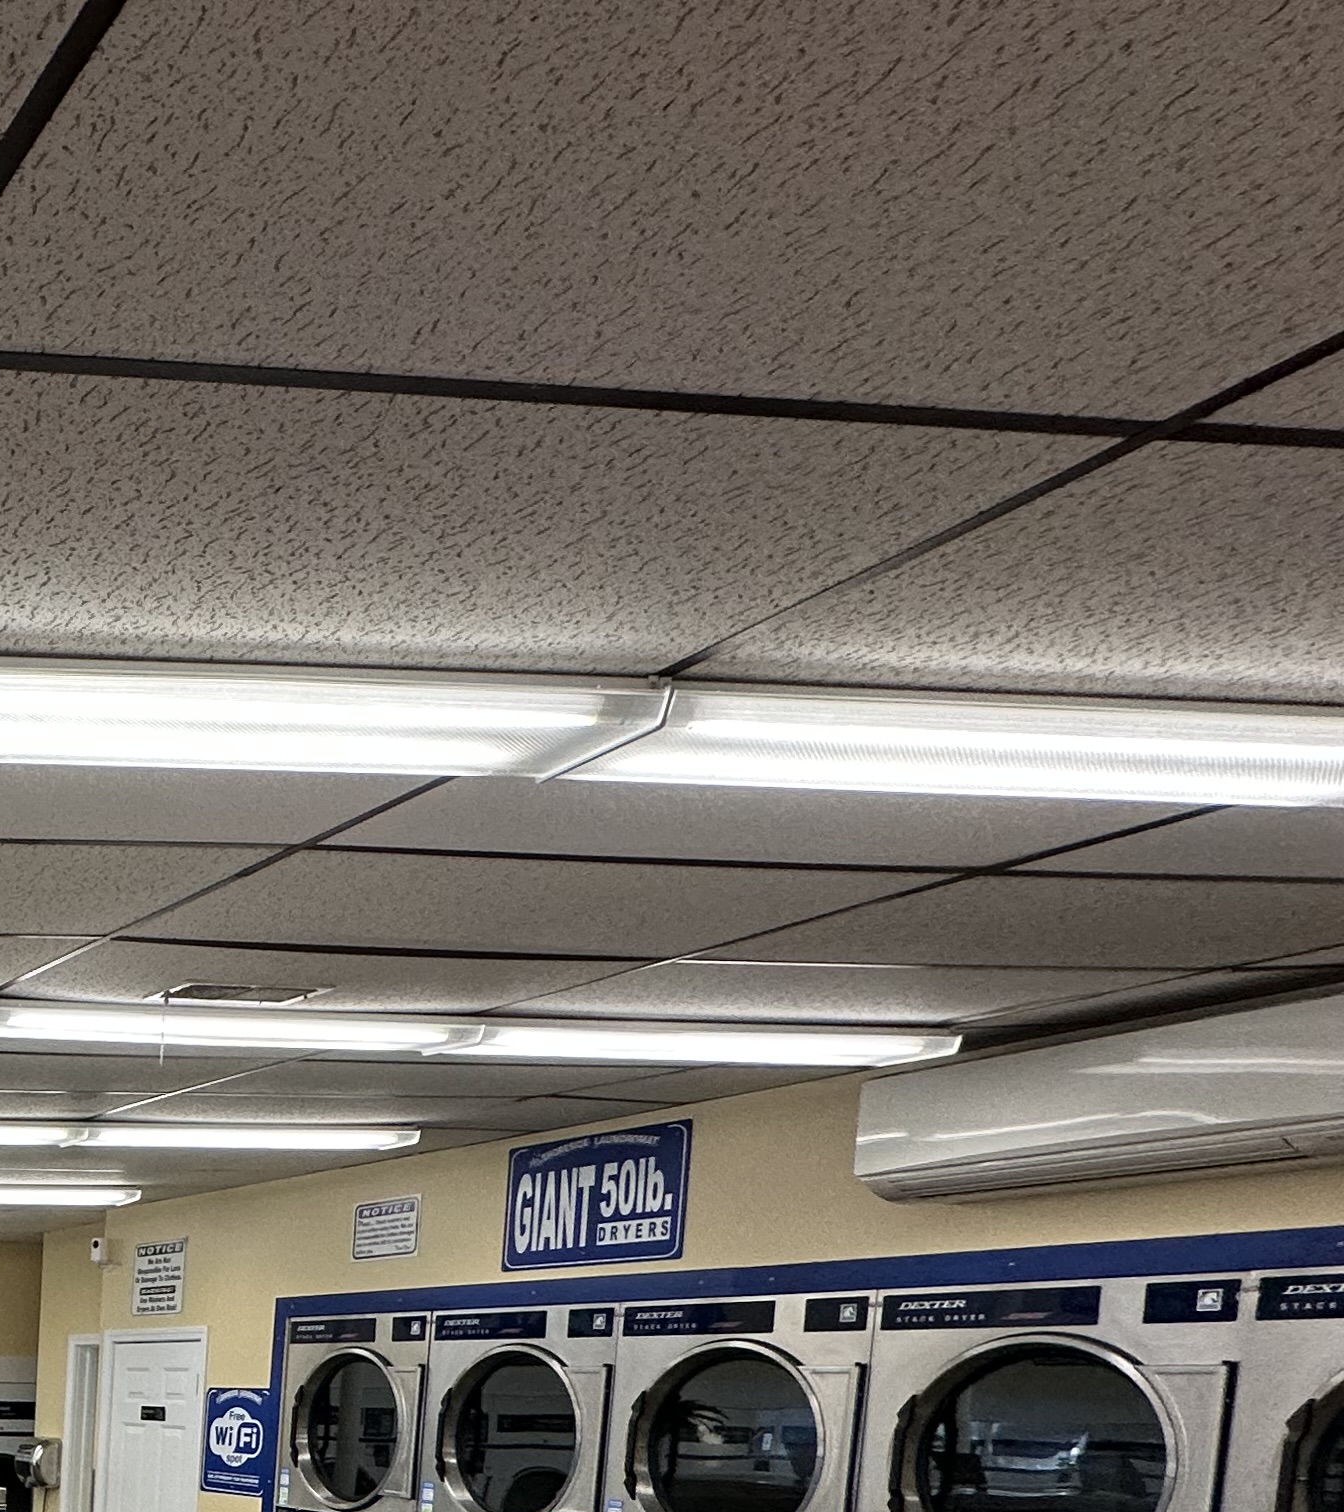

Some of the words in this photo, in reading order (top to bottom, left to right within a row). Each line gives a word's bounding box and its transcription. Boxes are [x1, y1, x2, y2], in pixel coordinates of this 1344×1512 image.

[362, 1202, 411, 1218] NOTICE
[514, 1164, 597, 1254] GIANT
[599, 1156, 673, 1218] 50lb.
[598, 1220, 669, 1242] DRYERS
[138, 1243, 183, 1256] NOTICE
[898, 1300, 967, 1311] DEXTER
[228, 1411, 246, 1421] Free
[226, 1455, 242, 1464] spot
